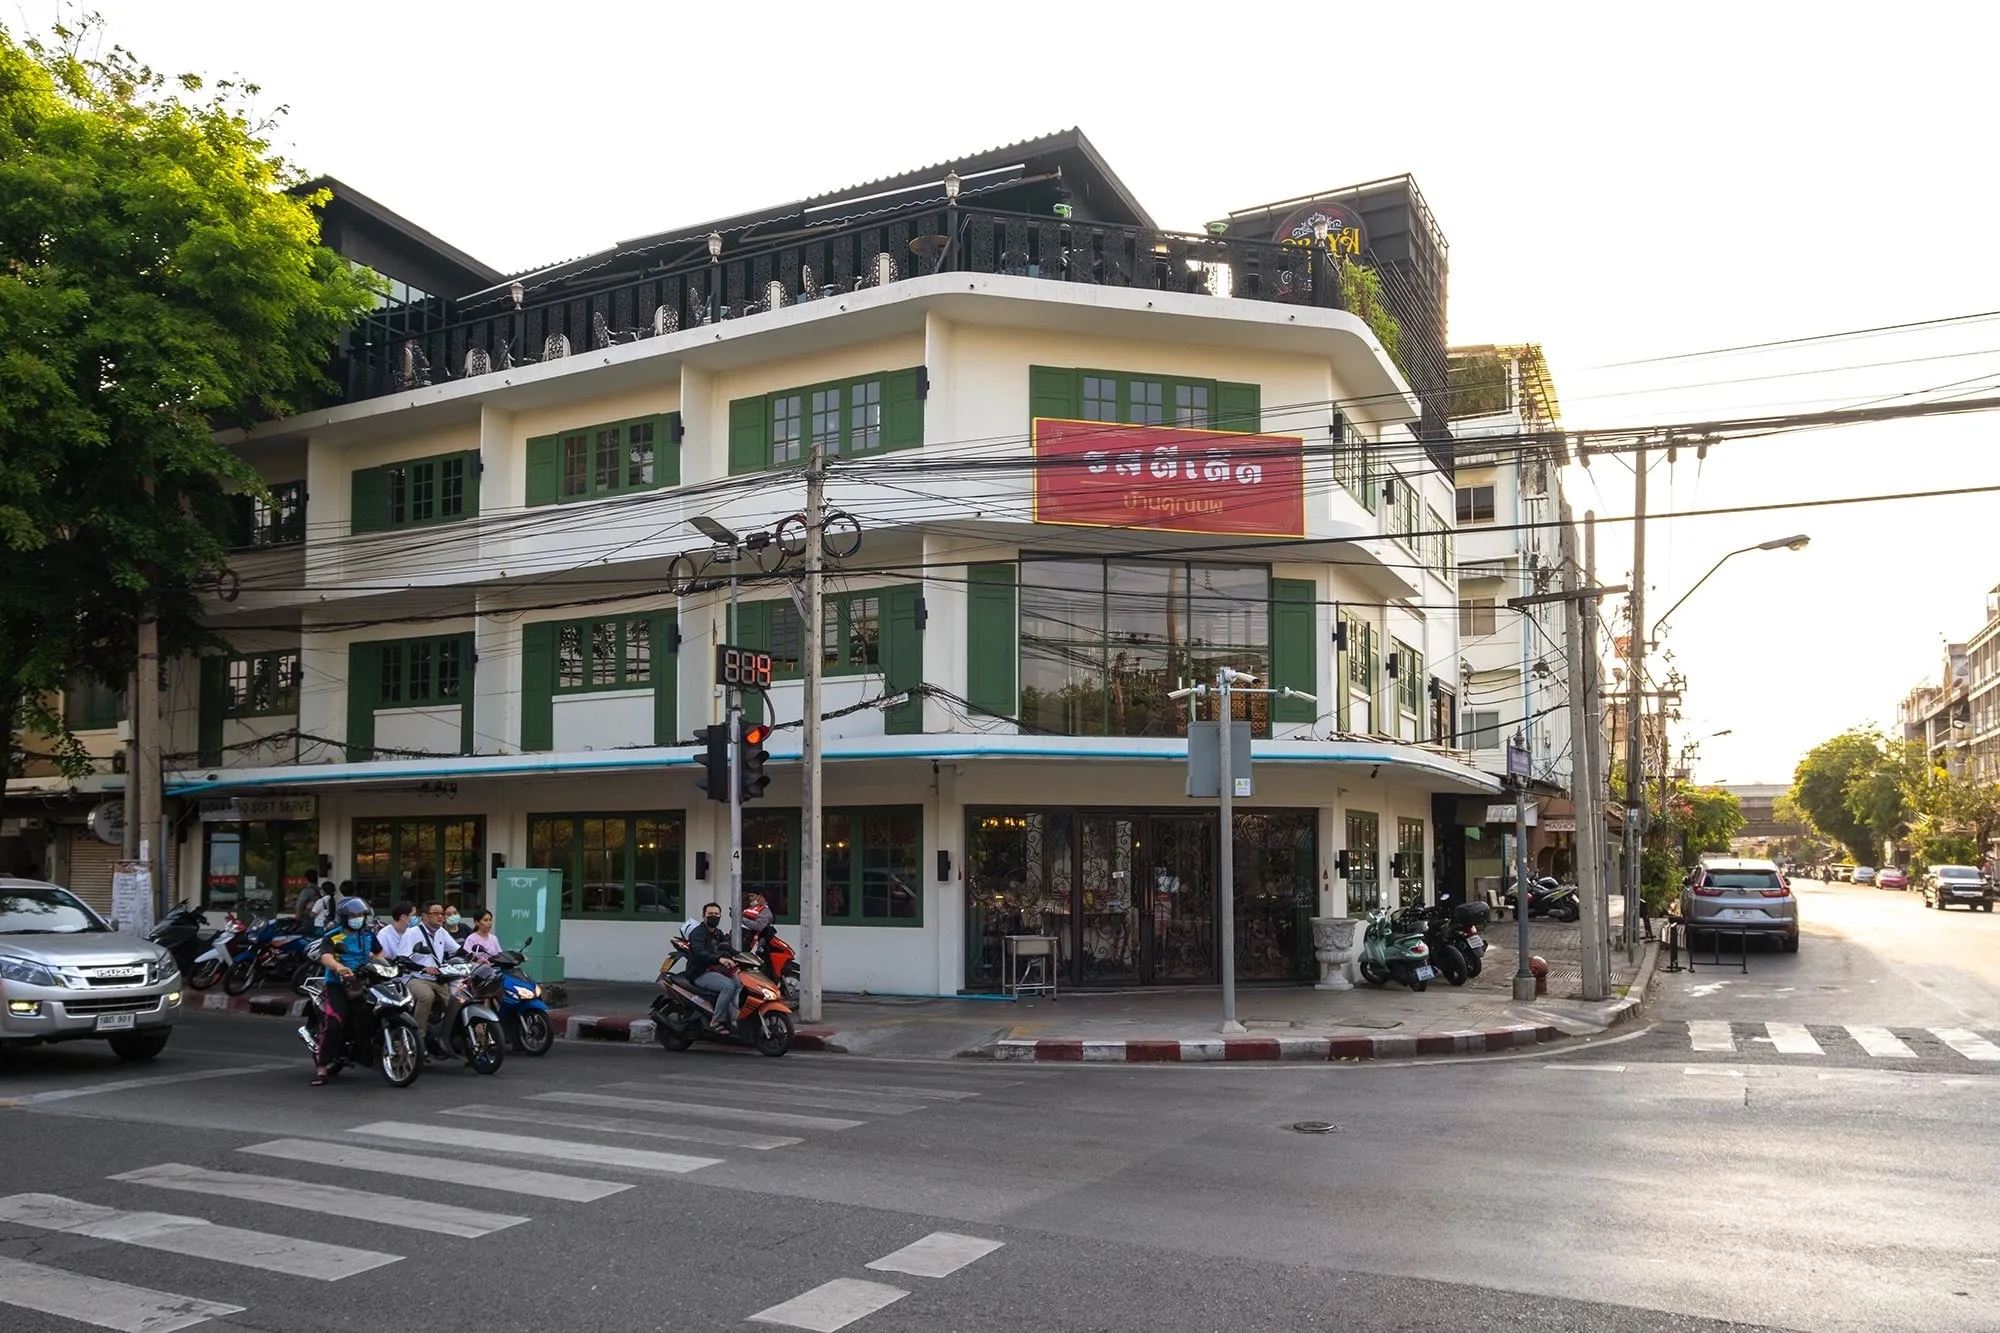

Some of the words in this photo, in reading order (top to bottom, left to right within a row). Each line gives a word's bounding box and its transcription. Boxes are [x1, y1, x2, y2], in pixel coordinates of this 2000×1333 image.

[251, 800, 275, 813] SOFT
[279, 799, 311, 812] SERVE
[733, 850, 740, 860] 4
[504, 877, 538, 888] TOT
[511, 909, 530, 919] PTW
